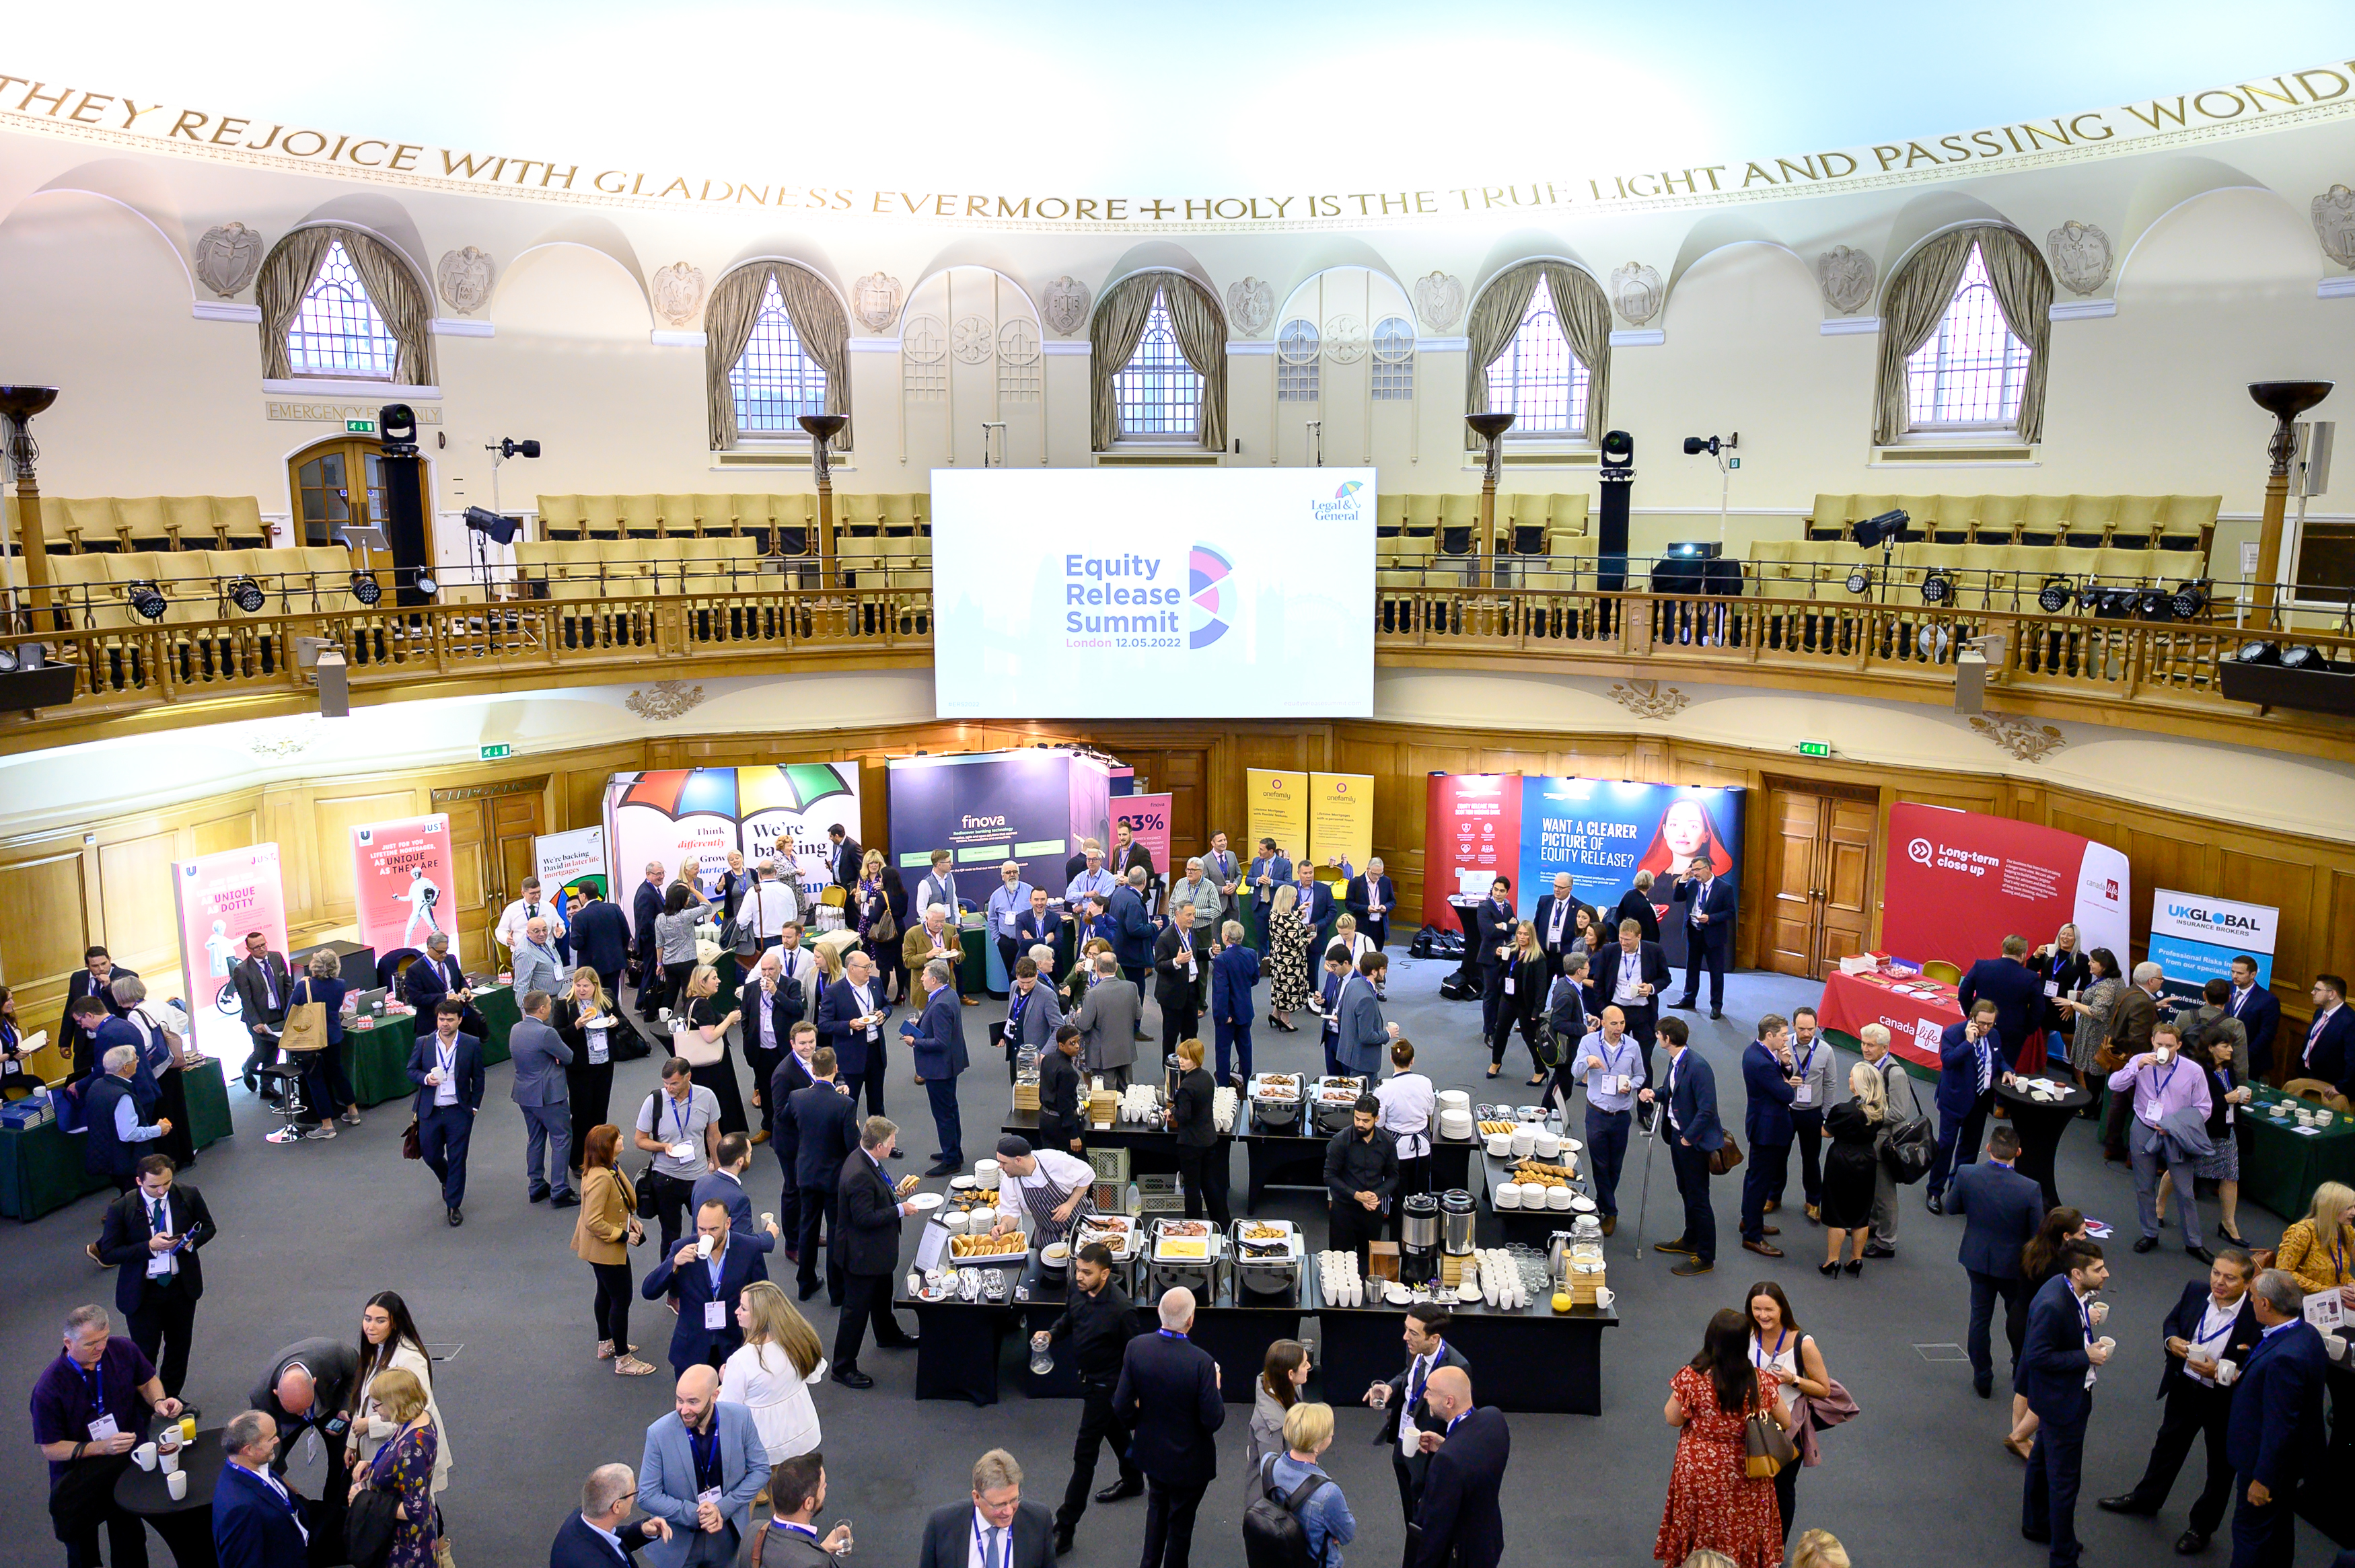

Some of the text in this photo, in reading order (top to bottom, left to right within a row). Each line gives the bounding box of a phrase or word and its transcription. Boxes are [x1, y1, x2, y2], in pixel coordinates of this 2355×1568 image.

[0, 74, 162, 130] THEY
[170, 109, 424, 172] REJOICE
[440, 149, 578, 189] WITH
[594, 170, 853, 211] GLADNESS
[873, 191, 1128, 221] EVERMORE
[1185, 196, 1295, 220] HOLY
[1307, 195, 1341, 217] IS
[1348, 190, 1439, 215] THE
[1449, 181, 1572, 211] TRUE
[1589, 164, 1726, 201] LIGHT
[1741, 152, 1858, 188] AND
[1872, 112, 2115, 170] PASSING
[269, 404, 362, 420] EMERGENCY
[414, 409, 440, 422] NLY
[1311, 499, 1353, 512] Legal &
[1315, 511, 1359, 521] General
[1066, 553, 1161, 580] Equity
[1066, 583, 1181, 605] Release
[1066, 610, 1179, 632] Summit
[1066, 637, 1182, 648] London 12.05.2022
[1263, 790, 1291, 800] onefamily
[1327, 794, 1356, 803] onefamily
[962, 814, 1005, 828] finova
[1542, 817, 1638, 839] WANT A CLEARER
[696, 827, 725, 835] Think
[678, 839, 725, 850] differently
[754, 841, 828, 858] baing
[1541, 832, 1605, 851] PICTURE OF
[370, 849, 398, 859] LIFETIME
[374, 852, 425, 866] AS UNIQUE
[544, 852, 589, 864] We're backing
[1541, 846, 1634, 868] EQUITY RELEASE?
[1939, 844, 2000, 867] Long-term
[379, 859, 439, 875] AS THEY ARE
[544, 862, 563, 872] David
[544, 868, 579, 879] mortgages
[1937, 857, 1985, 877] close up
[215, 887, 255, 903] UNIQUE
[2087, 879, 2118, 898] canada life
[221, 897, 254, 913] DOTTY
[2168, 903, 2261, 931] UKGLOBAL
[2176, 919, 2249, 936] INSURANCE BROKERS
[2159, 948, 2202, 962] Professional
[2202, 957, 2222, 966] Risks
[2165, 957, 2181, 967] from
[2197, 964, 2230, 976] specialist
[1879, 1015, 1941, 1047] canada life
